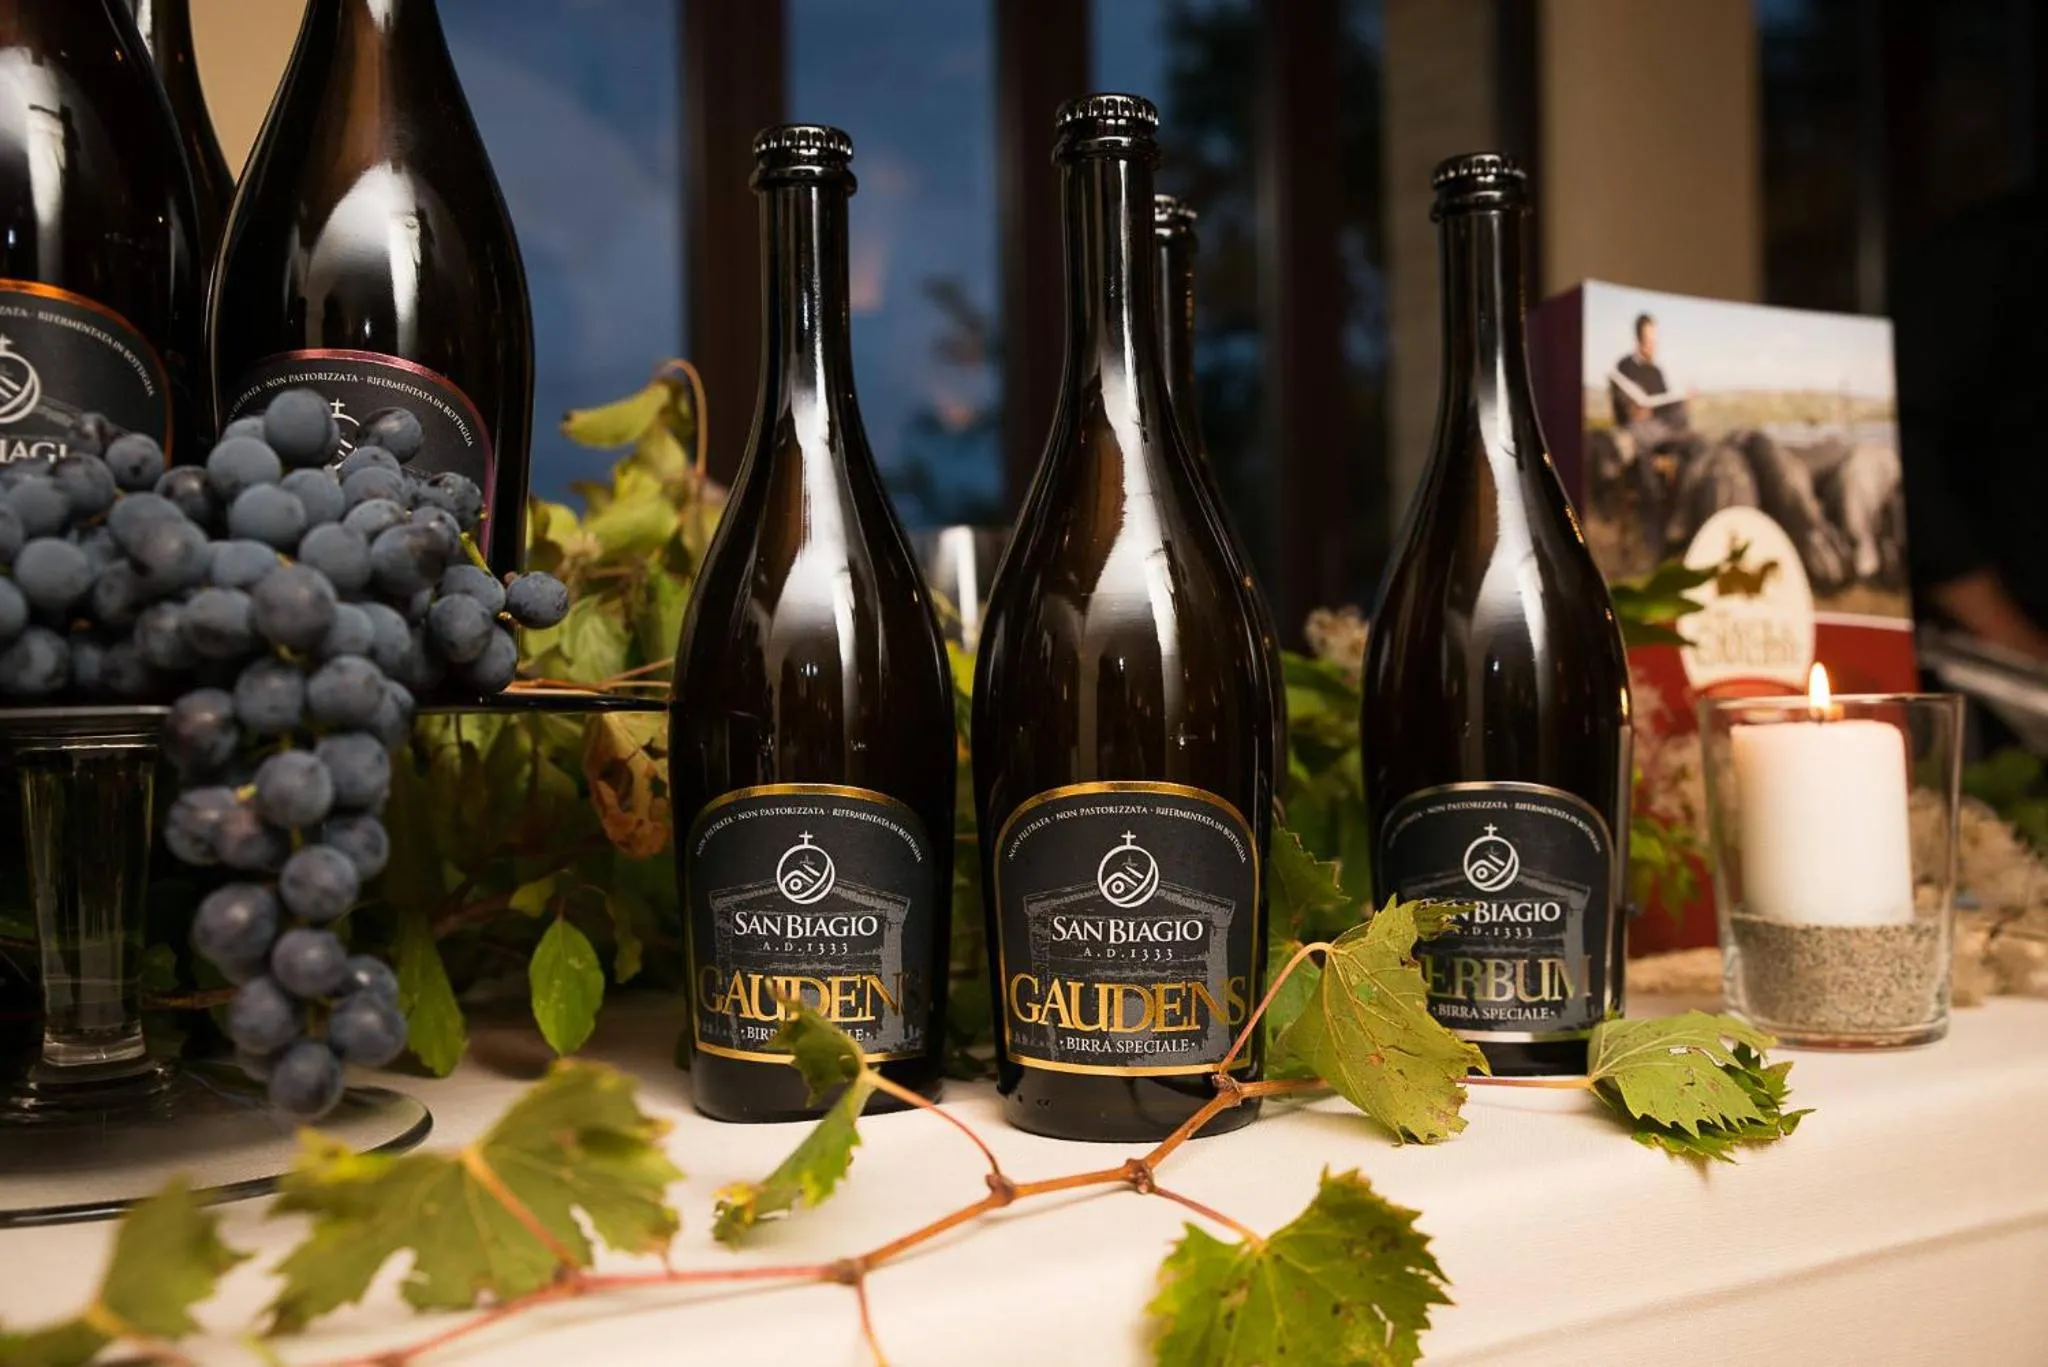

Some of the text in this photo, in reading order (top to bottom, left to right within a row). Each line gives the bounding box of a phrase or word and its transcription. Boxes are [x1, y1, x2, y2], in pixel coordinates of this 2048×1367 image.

[37, 311, 113, 346] RIFERMENTATA
[113, 340, 125, 354] IN
[265, 375, 287, 389] NON
[289, 373, 358, 383] PASTORIZZATA
[366, 376, 434, 404] RIFERMENTATA
[432, 397, 444, 410] IN
[442, 406, 473, 447] BOTTIGLIA
[0, 439, 69, 464] IAGI
[1447, 801, 1508, 811] PASTORIZZATA
[738, 809, 758, 820] NON
[759, 806, 825, 816] PASTORIZZATA
[832, 808, 890, 828] RIFERMENTATA
[897, 827, 923, 864] BOTTIGLIA
[1008, 805, 1247, 864] NON FILTRATA NON PASTORIZZATA RIFERMENTATA IN BOTTIGLIA
[734, 912, 879, 939] SAN BIAGIO
[1474, 900, 1562, 925] BIAGIO
[1052, 916, 1204, 945] SAN BIAGIO
[1420, 954, 1592, 1003] ERBUM
[1010, 972, 1247, 1033] GAUDENS
[1482, 1007, 1550, 1021] SPECIALE
[1116, 1038, 1189, 1054] SPECIALE
